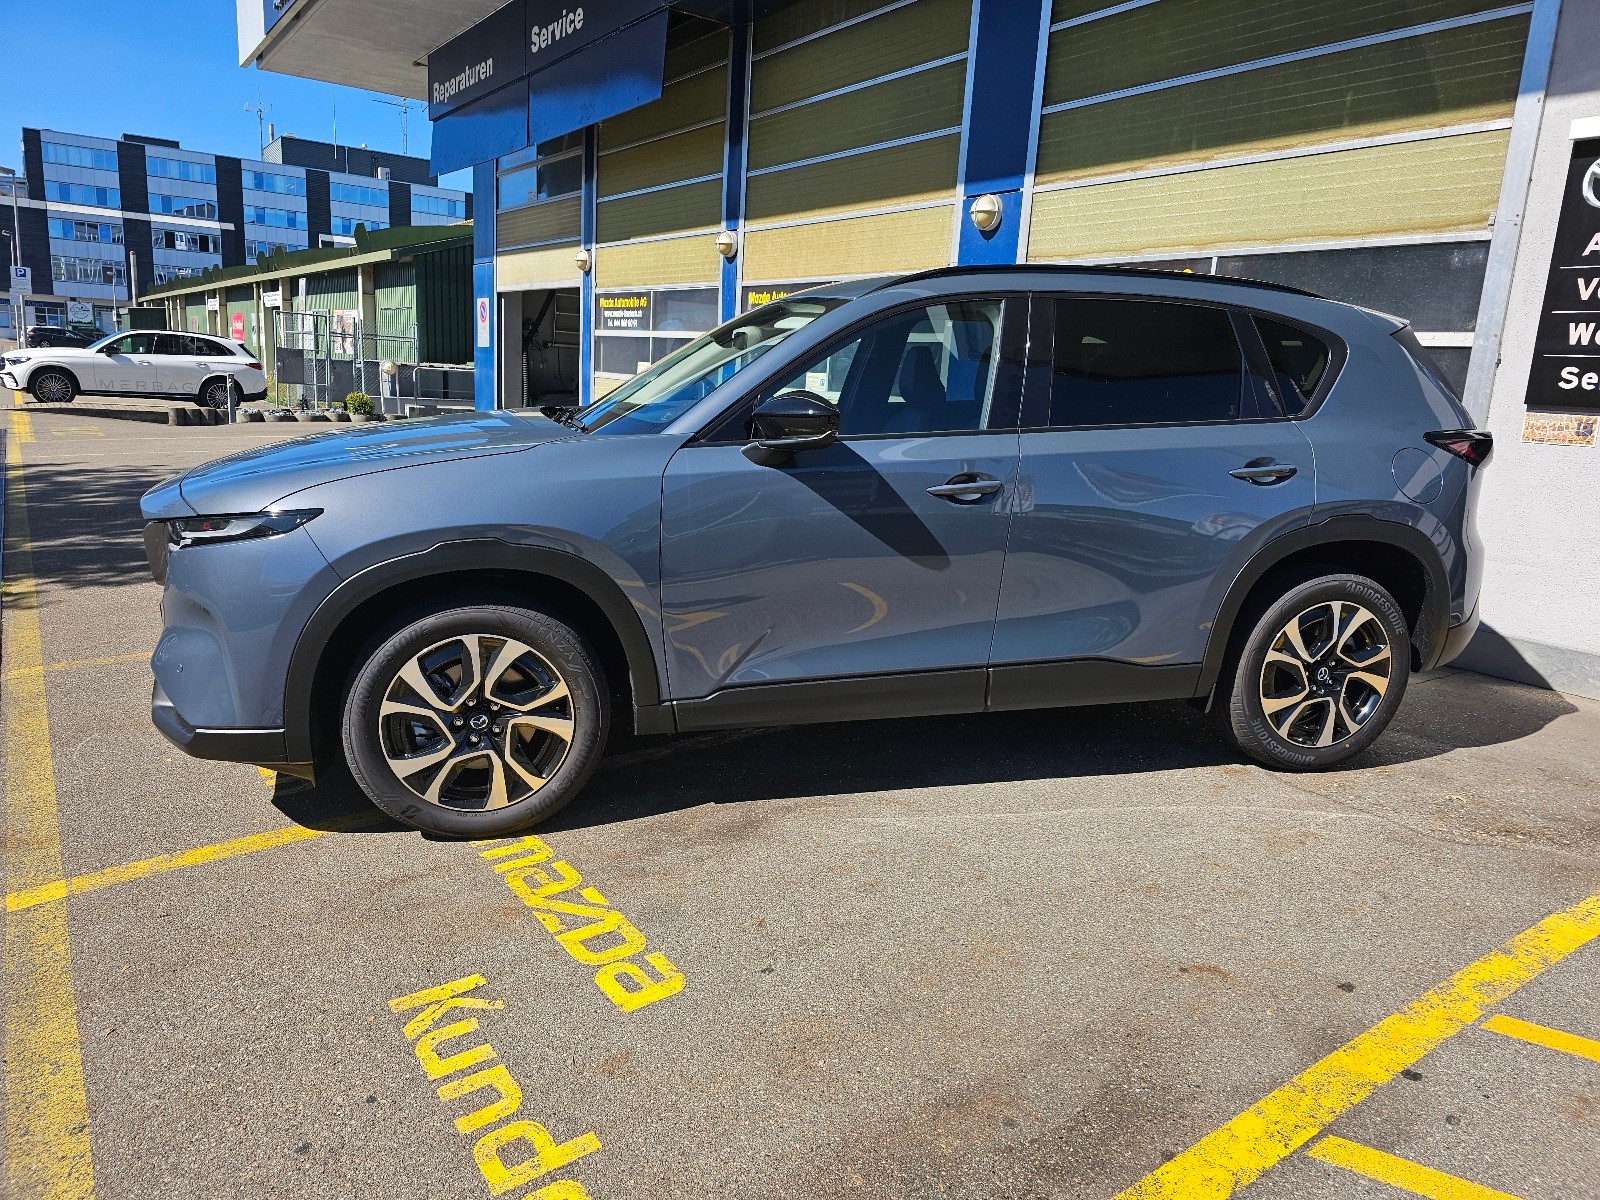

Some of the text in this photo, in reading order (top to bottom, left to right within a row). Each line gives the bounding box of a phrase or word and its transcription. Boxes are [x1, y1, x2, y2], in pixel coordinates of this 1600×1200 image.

[530, 7, 584, 53] Service
[433, 57, 493, 104] Reparaturen
[1577, 277, 1600, 301] V
[1569, 322, 1600, 346] W
[100, 380, 194, 392] MERBAG
[1557, 366, 1600, 391] Se
[1345, 581, 1405, 635] BRIDGESTONE
[1250, 717, 1317, 765] BRIDGESTONE
[388, 973, 603, 1200] Kund
